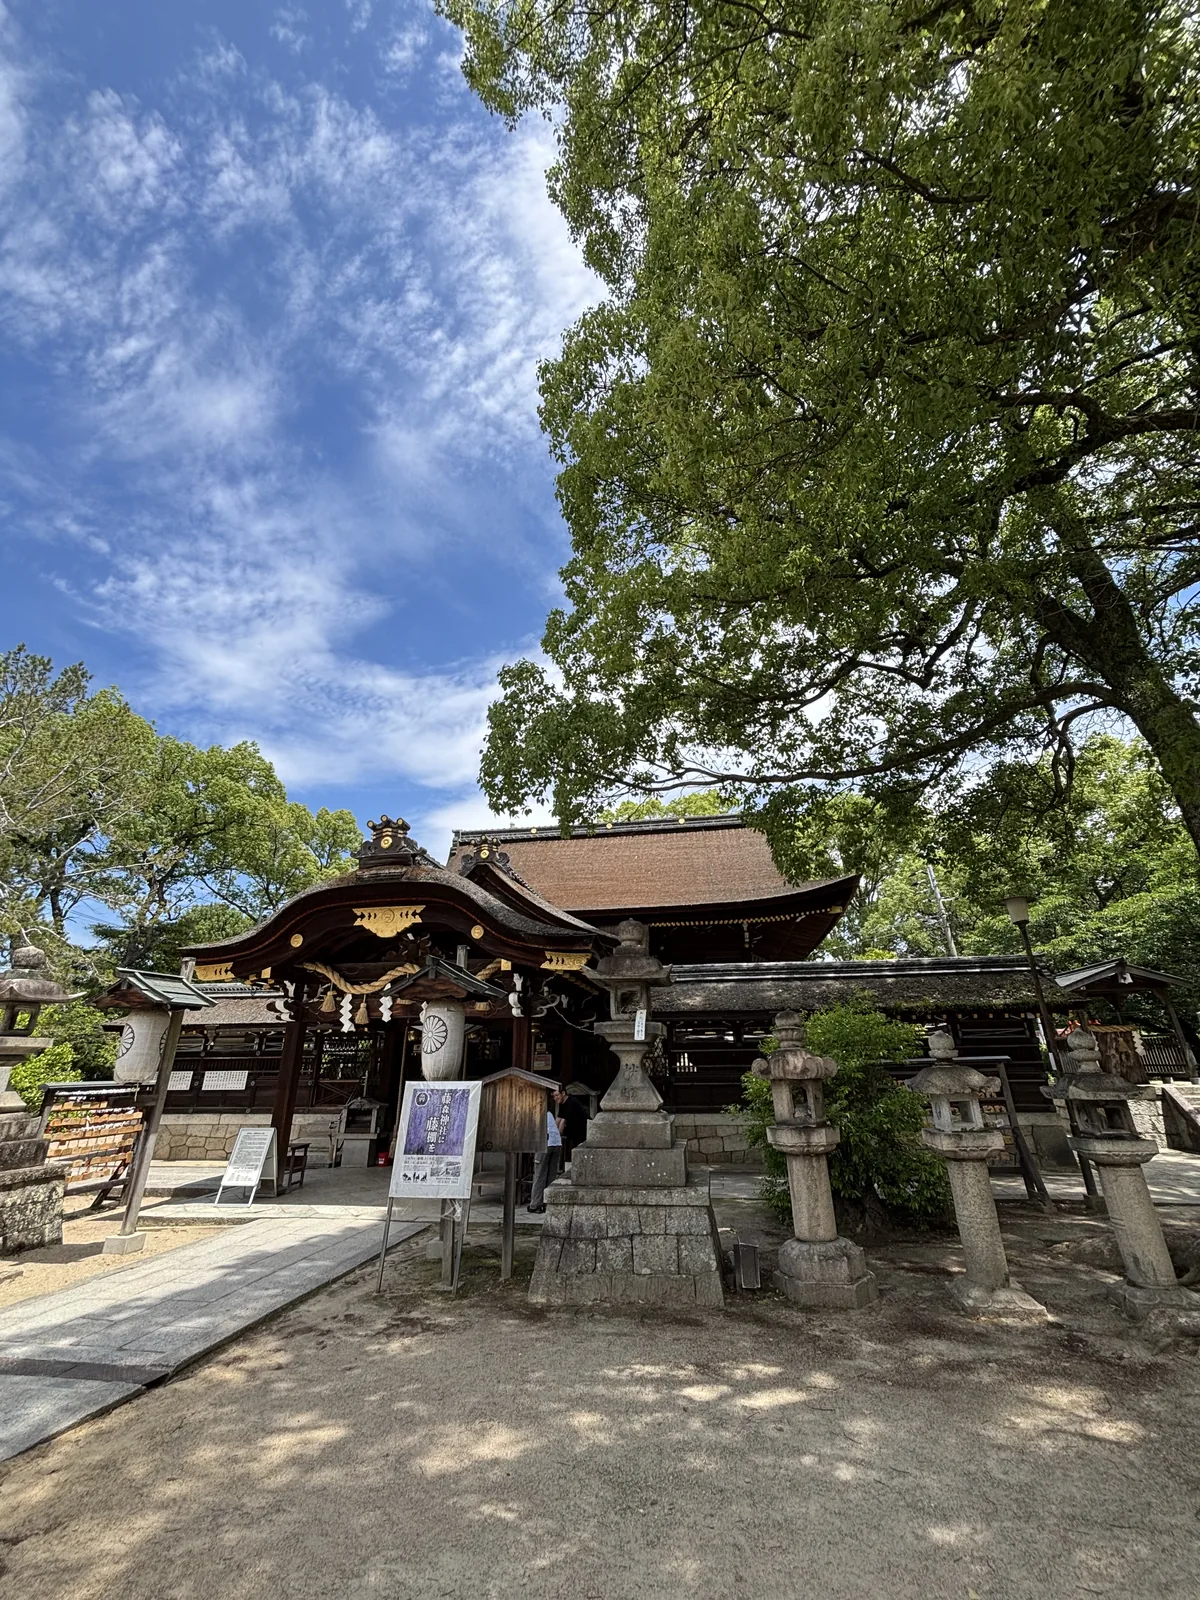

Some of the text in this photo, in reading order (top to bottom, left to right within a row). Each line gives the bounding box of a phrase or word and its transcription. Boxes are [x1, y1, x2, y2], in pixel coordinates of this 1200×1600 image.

[426, 1116, 440, 1153] 藤棚を
[438, 1092, 452, 1144] 藤森神社に
